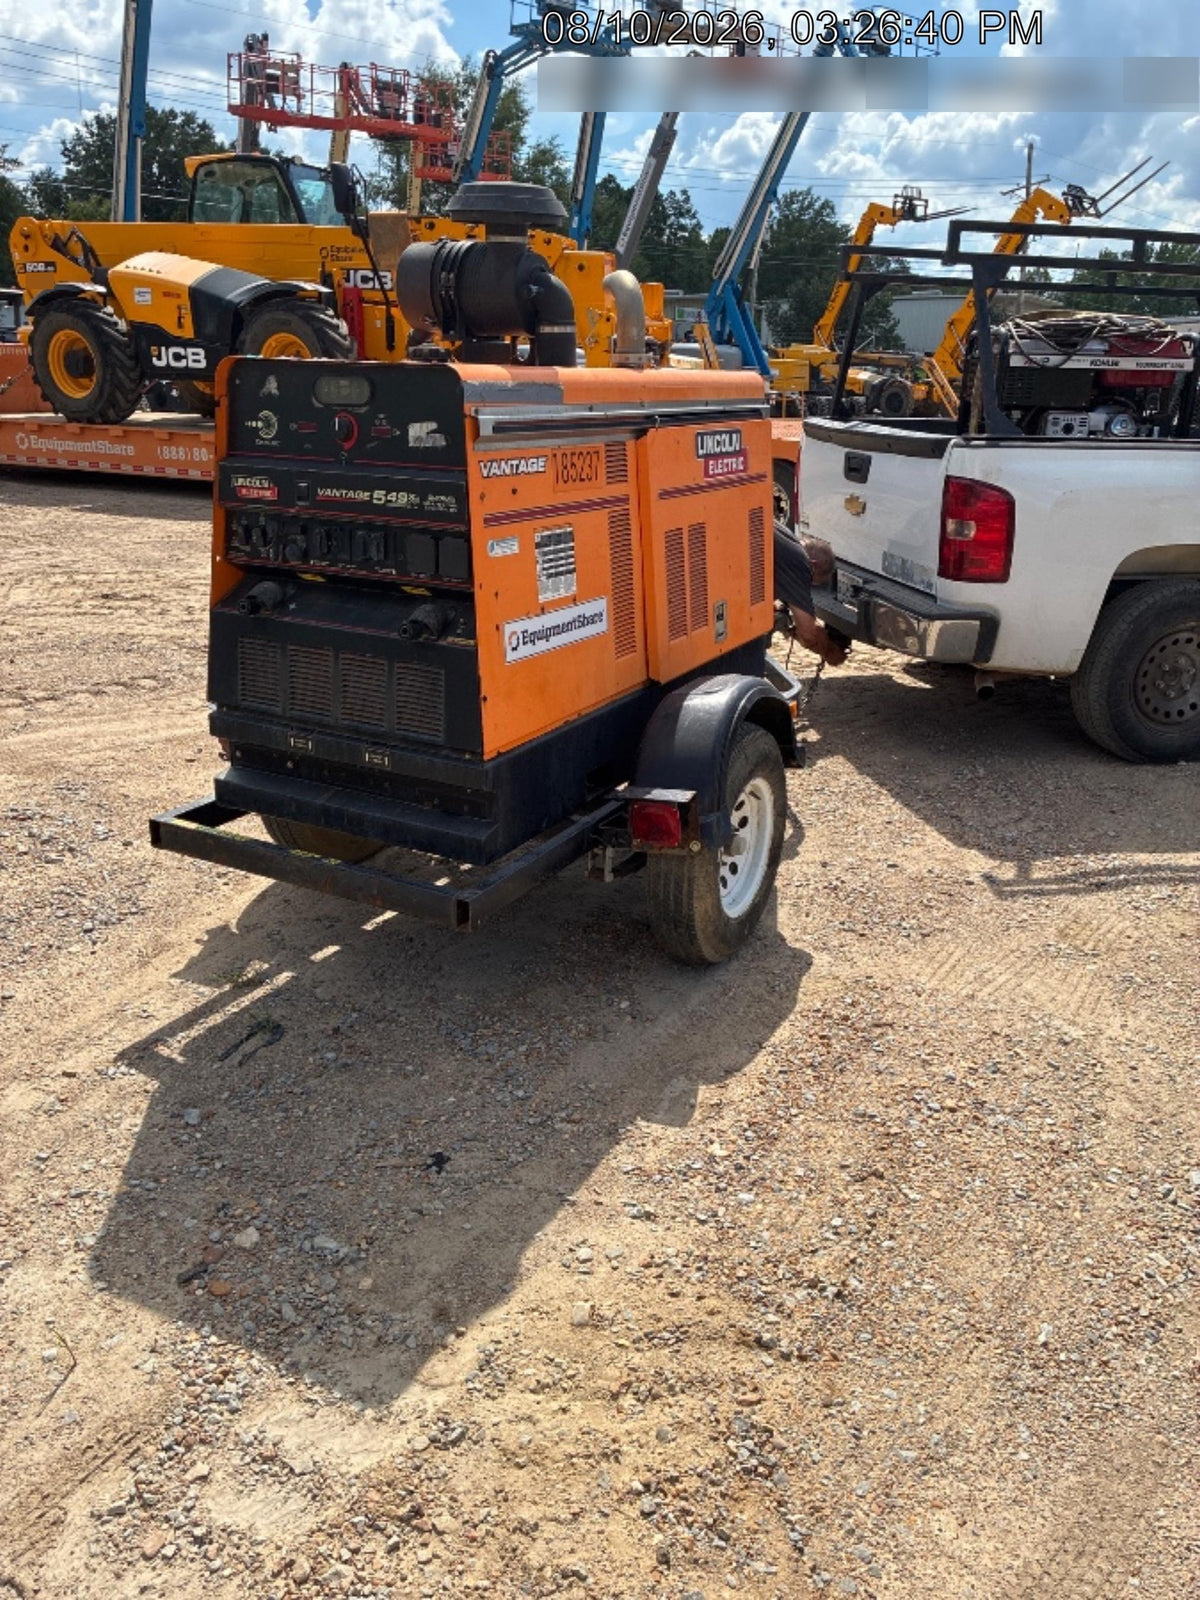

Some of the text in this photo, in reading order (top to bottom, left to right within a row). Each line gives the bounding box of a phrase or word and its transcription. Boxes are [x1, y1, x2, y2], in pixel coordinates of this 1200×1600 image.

[342, 269, 392, 289] JCB
[150, 345, 207, 368] JCB
[30, 435, 136, 456] EquipmentShare
[697, 432, 741, 456] LINCOLN
[479, 455, 548, 478] VANTAGE
[552, 450, 601, 484] 185237
[708, 456, 745, 475] ELECTRIC
[317, 488, 371, 500] VANTAGE
[521, 611, 605, 646] EquipmentShare
